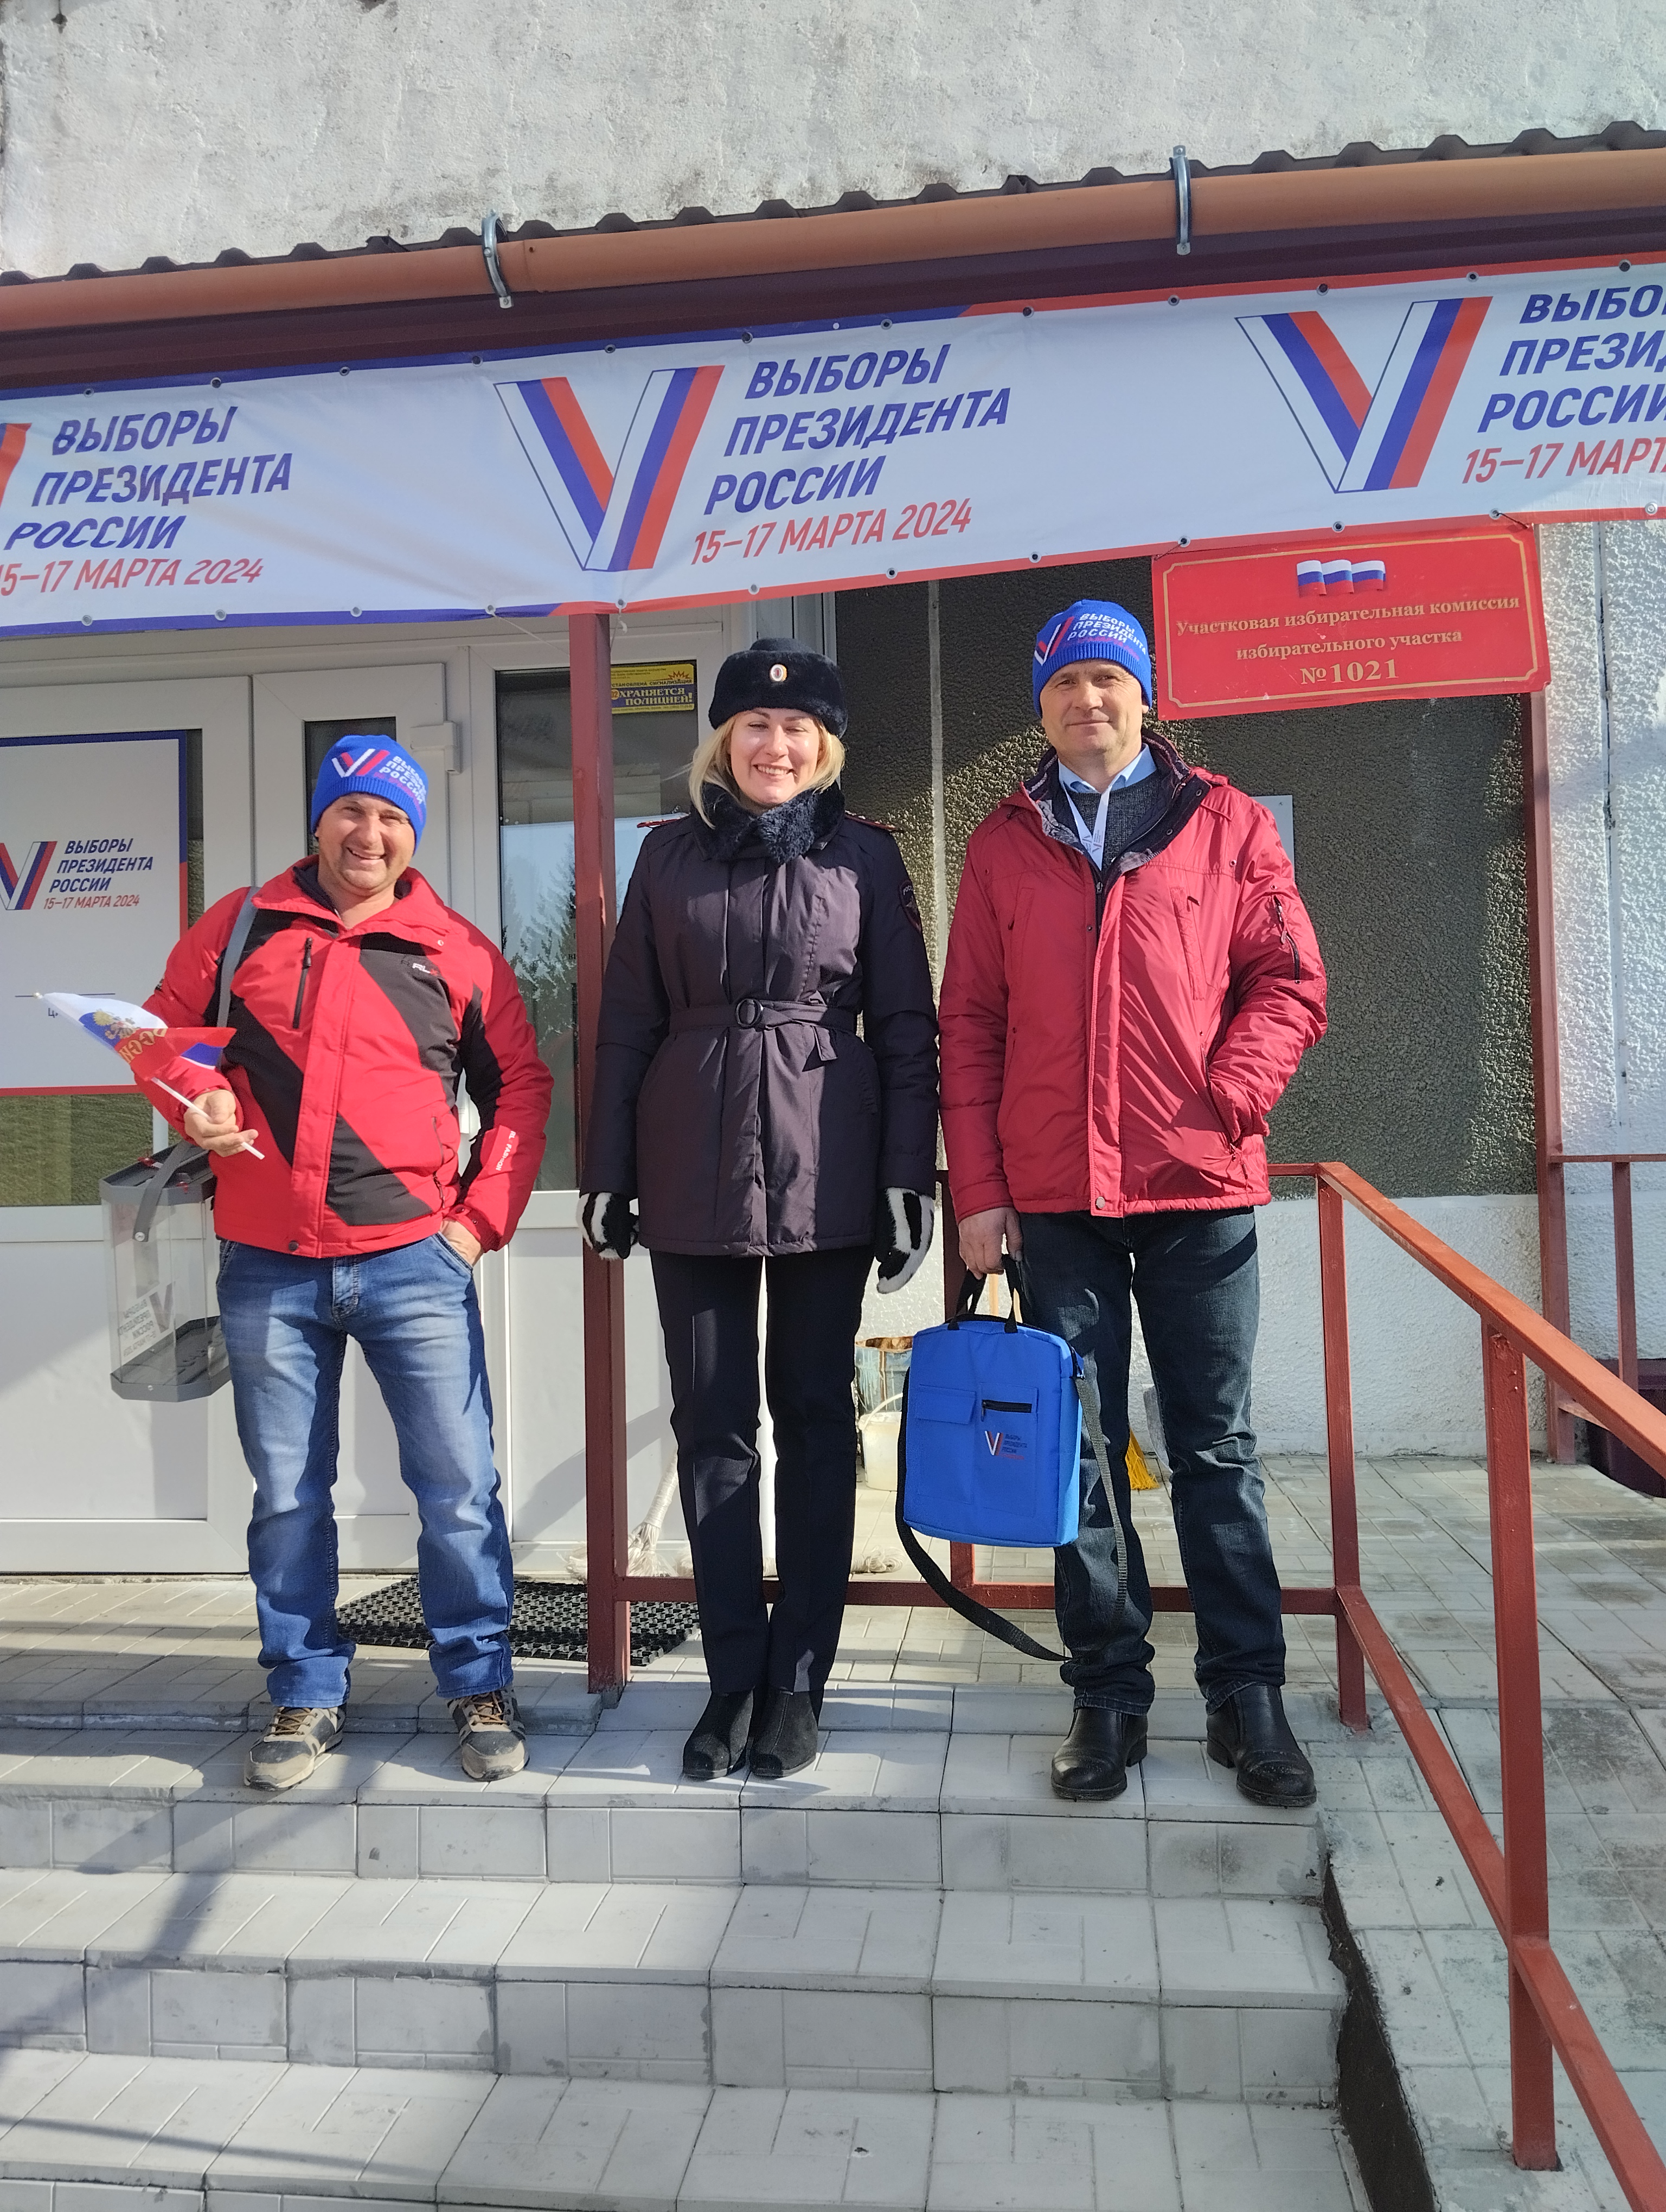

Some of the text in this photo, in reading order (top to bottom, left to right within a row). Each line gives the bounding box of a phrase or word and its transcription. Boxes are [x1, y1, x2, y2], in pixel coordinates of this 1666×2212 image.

[1519, 285, 1666, 324] ВЫБО
[745, 344, 951, 400] ВЫБОРЫ
[1499, 330, 1666, 376] ПРЕЗИ
[52, 406, 238, 456] ВЫБОРЫ
[723, 387, 1010, 456] ПРЕЗИДЕНТА
[1565, 437, 1666, 477] МАРТ
[31, 453, 293, 507] ПРЕЗИДЕНТА
[704, 455, 887, 515] РОССИИ
[3, 515, 187, 550] РОССИИ
[778, 508, 887, 555] МАРТА
[892, 497, 971, 541] 2024
[73, 558, 182, 591] МАРТА
[184, 557, 264, 586] 2024
[1067, 628, 1127, 644] РОССИИ
[1079, 613, 1135, 634] ВЫБОРЫ
[1176, 597, 1520, 636] Участковая избирательная комиссия
[1073, 621, 1146, 655] ПРЕЗИДЕНТА
[1236, 629, 1463, 660] избирательного участка
[379, 766, 423, 805] РОССИИ
[56, 857, 153, 874] ПРЕЗИДЕНТА
[64, 838, 134, 854] ВЫБОРЫ
[49, 877, 112, 893] РОССИИ
[74, 896, 112, 909] МАРТА
[113, 895, 140, 908] 2024
